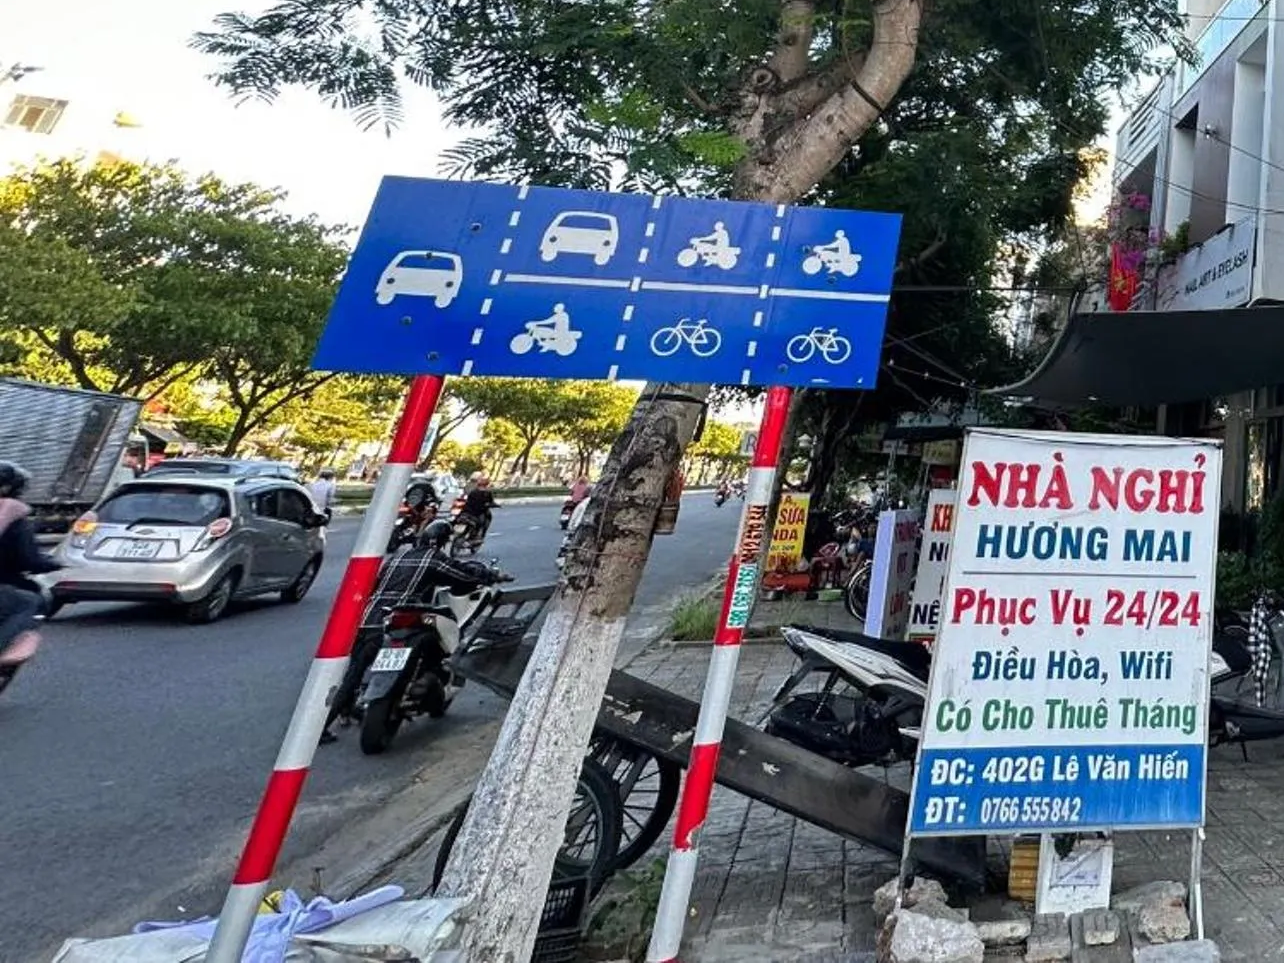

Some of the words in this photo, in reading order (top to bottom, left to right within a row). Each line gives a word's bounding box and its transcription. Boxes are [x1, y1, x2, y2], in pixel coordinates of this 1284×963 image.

[967, 452, 1074, 510] NHÀ
[1088, 453, 1206, 514] NGHỈ
[976, 521, 1109, 560] HƯƠNG
[1122, 529, 1192, 562] MAI
[951, 587, 1037, 637] Phục
[1050, 589, 1092, 637] Vụ
[1103, 589, 1201, 630] 24/24
[972, 646, 1036, 681] Điều
[1046, 649, 1108, 685] Hòa,
[1120, 650, 1174, 680] Wifi
[936, 699, 972, 732] Có
[982, 698, 1035, 731] Cho
[1045, 697, 1109, 729] Thuê
[1119, 697, 1197, 734] Tháng
[931, 758, 974, 785] ĐC:
[982, 756, 1045, 783] 402G
[1052, 755, 1080, 782] Lê
[1088, 754, 1130, 781] Văn
[1138, 750, 1189, 780] Hiến
[925, 797, 967, 824] ĐT:
